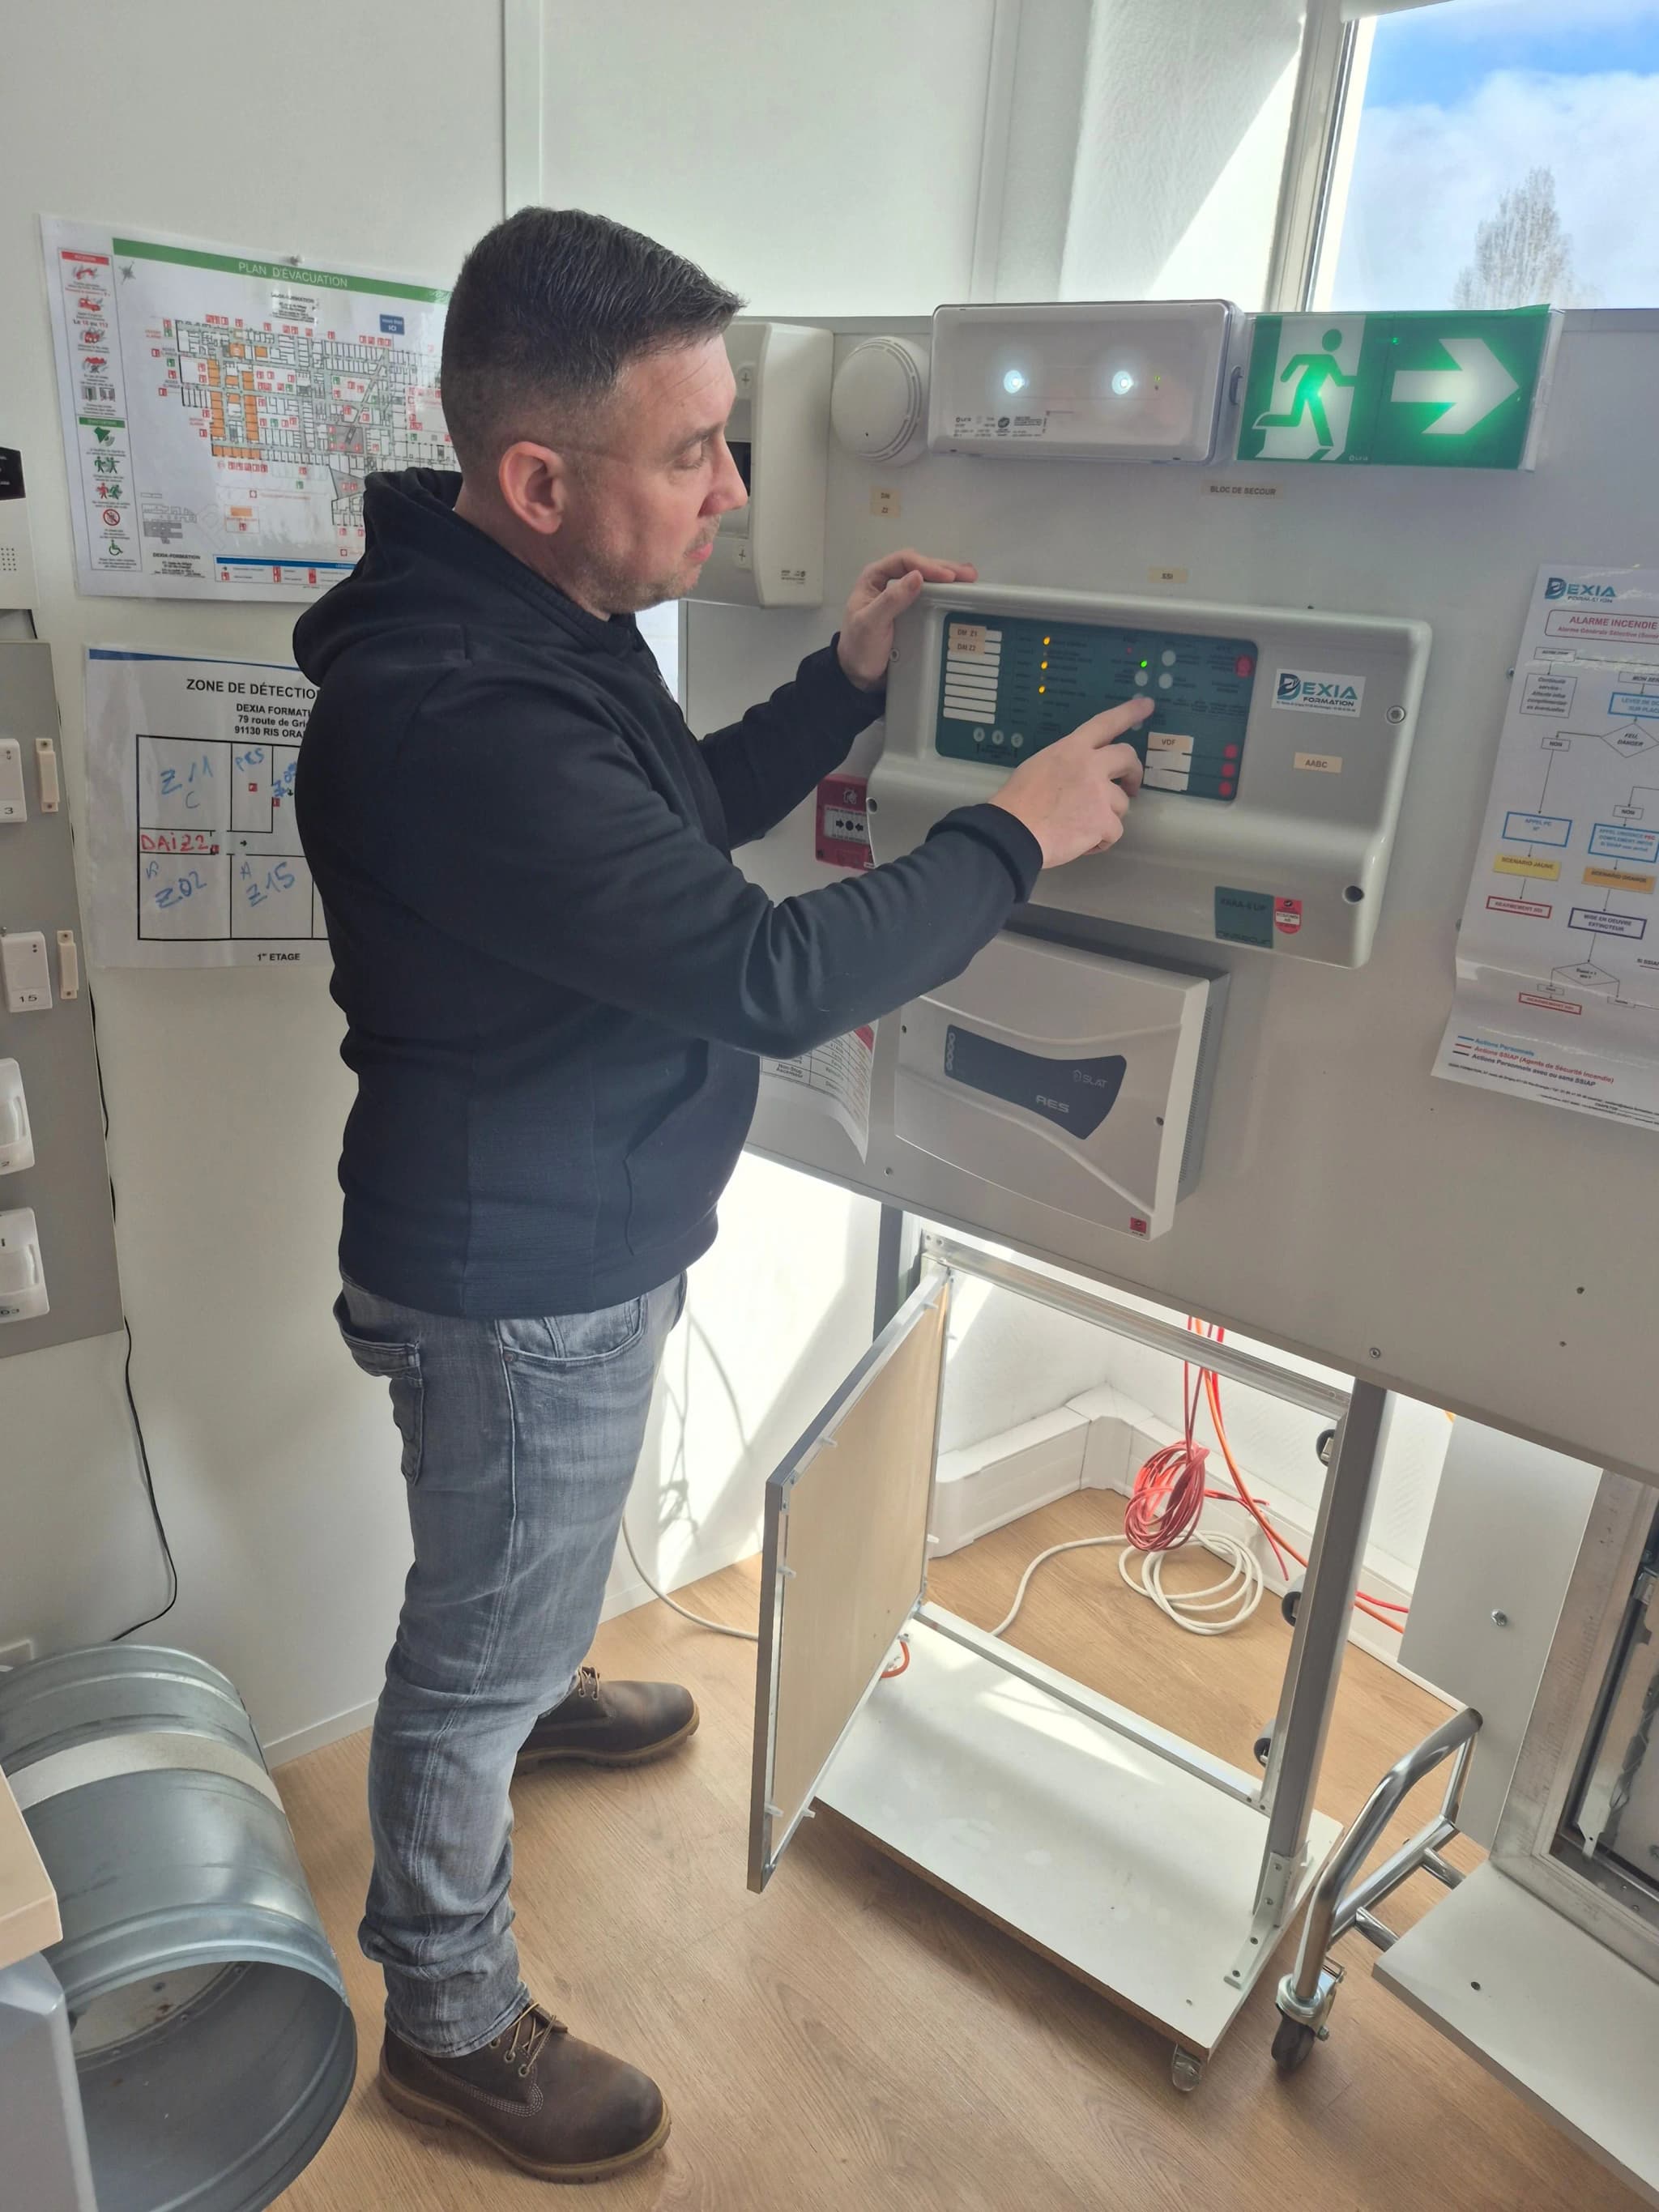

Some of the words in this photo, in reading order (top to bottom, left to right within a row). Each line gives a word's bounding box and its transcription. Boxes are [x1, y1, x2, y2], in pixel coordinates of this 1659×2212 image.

[238, 262, 267, 275] PLAN
[1545, 578, 1617, 599] DEXIA
[1569, 616, 1610, 626] ALARME
[1610, 620, 1658, 630] INCENDIE
[186, 679, 224, 692] ZONE
[228, 682, 245, 694] DE
[250, 682, 316, 700] DÉTECTIO
[1277, 673, 1358, 700] DEXIA
[1303, 697, 1354, 706] FORMATION
[237, 703, 266, 714] DEXIA
[268, 706, 311, 718] FORMATI
[239, 714, 249, 723] 79
[251, 717, 275, 726] route
[292, 719, 309, 727] Gri
[235, 726, 261, 735] 91130
[263, 727, 279, 736] RIS
[282, 729, 304, 739] ORA
[1305, 759, 1328, 769] AABC
[1501, 857, 1533, 867] SCENARIO
[1533, 861, 1555, 869] JAUNE
[270, 953, 301, 961] ETAGE
[19, 994, 37, 1003] 15
[1472, 1053, 1495, 1063] Actions
[1082, 1074, 1107, 1089] SLAT
[1036, 1094, 1070, 1113] AES
